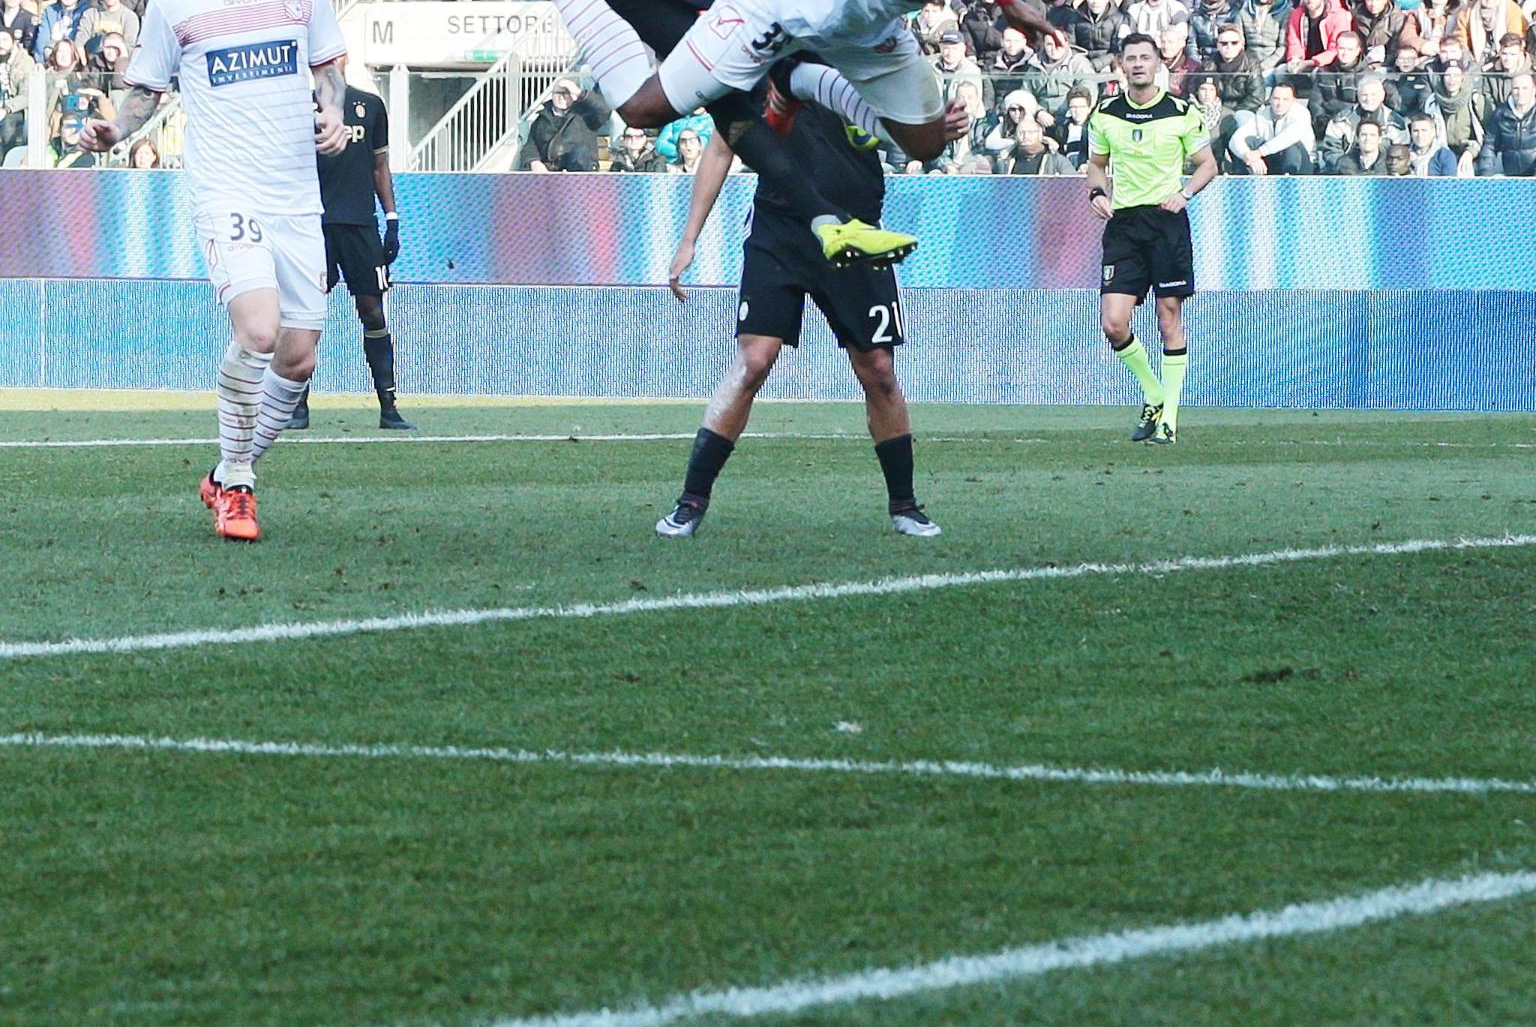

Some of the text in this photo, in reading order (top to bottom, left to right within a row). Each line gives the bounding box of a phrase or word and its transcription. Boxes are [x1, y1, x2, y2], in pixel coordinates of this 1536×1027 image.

[372, 20, 394, 45] M
[447, 14, 553, 35] SETTORE
[211, 44, 291, 75] AZIMUT
[229, 212, 264, 244] 39
